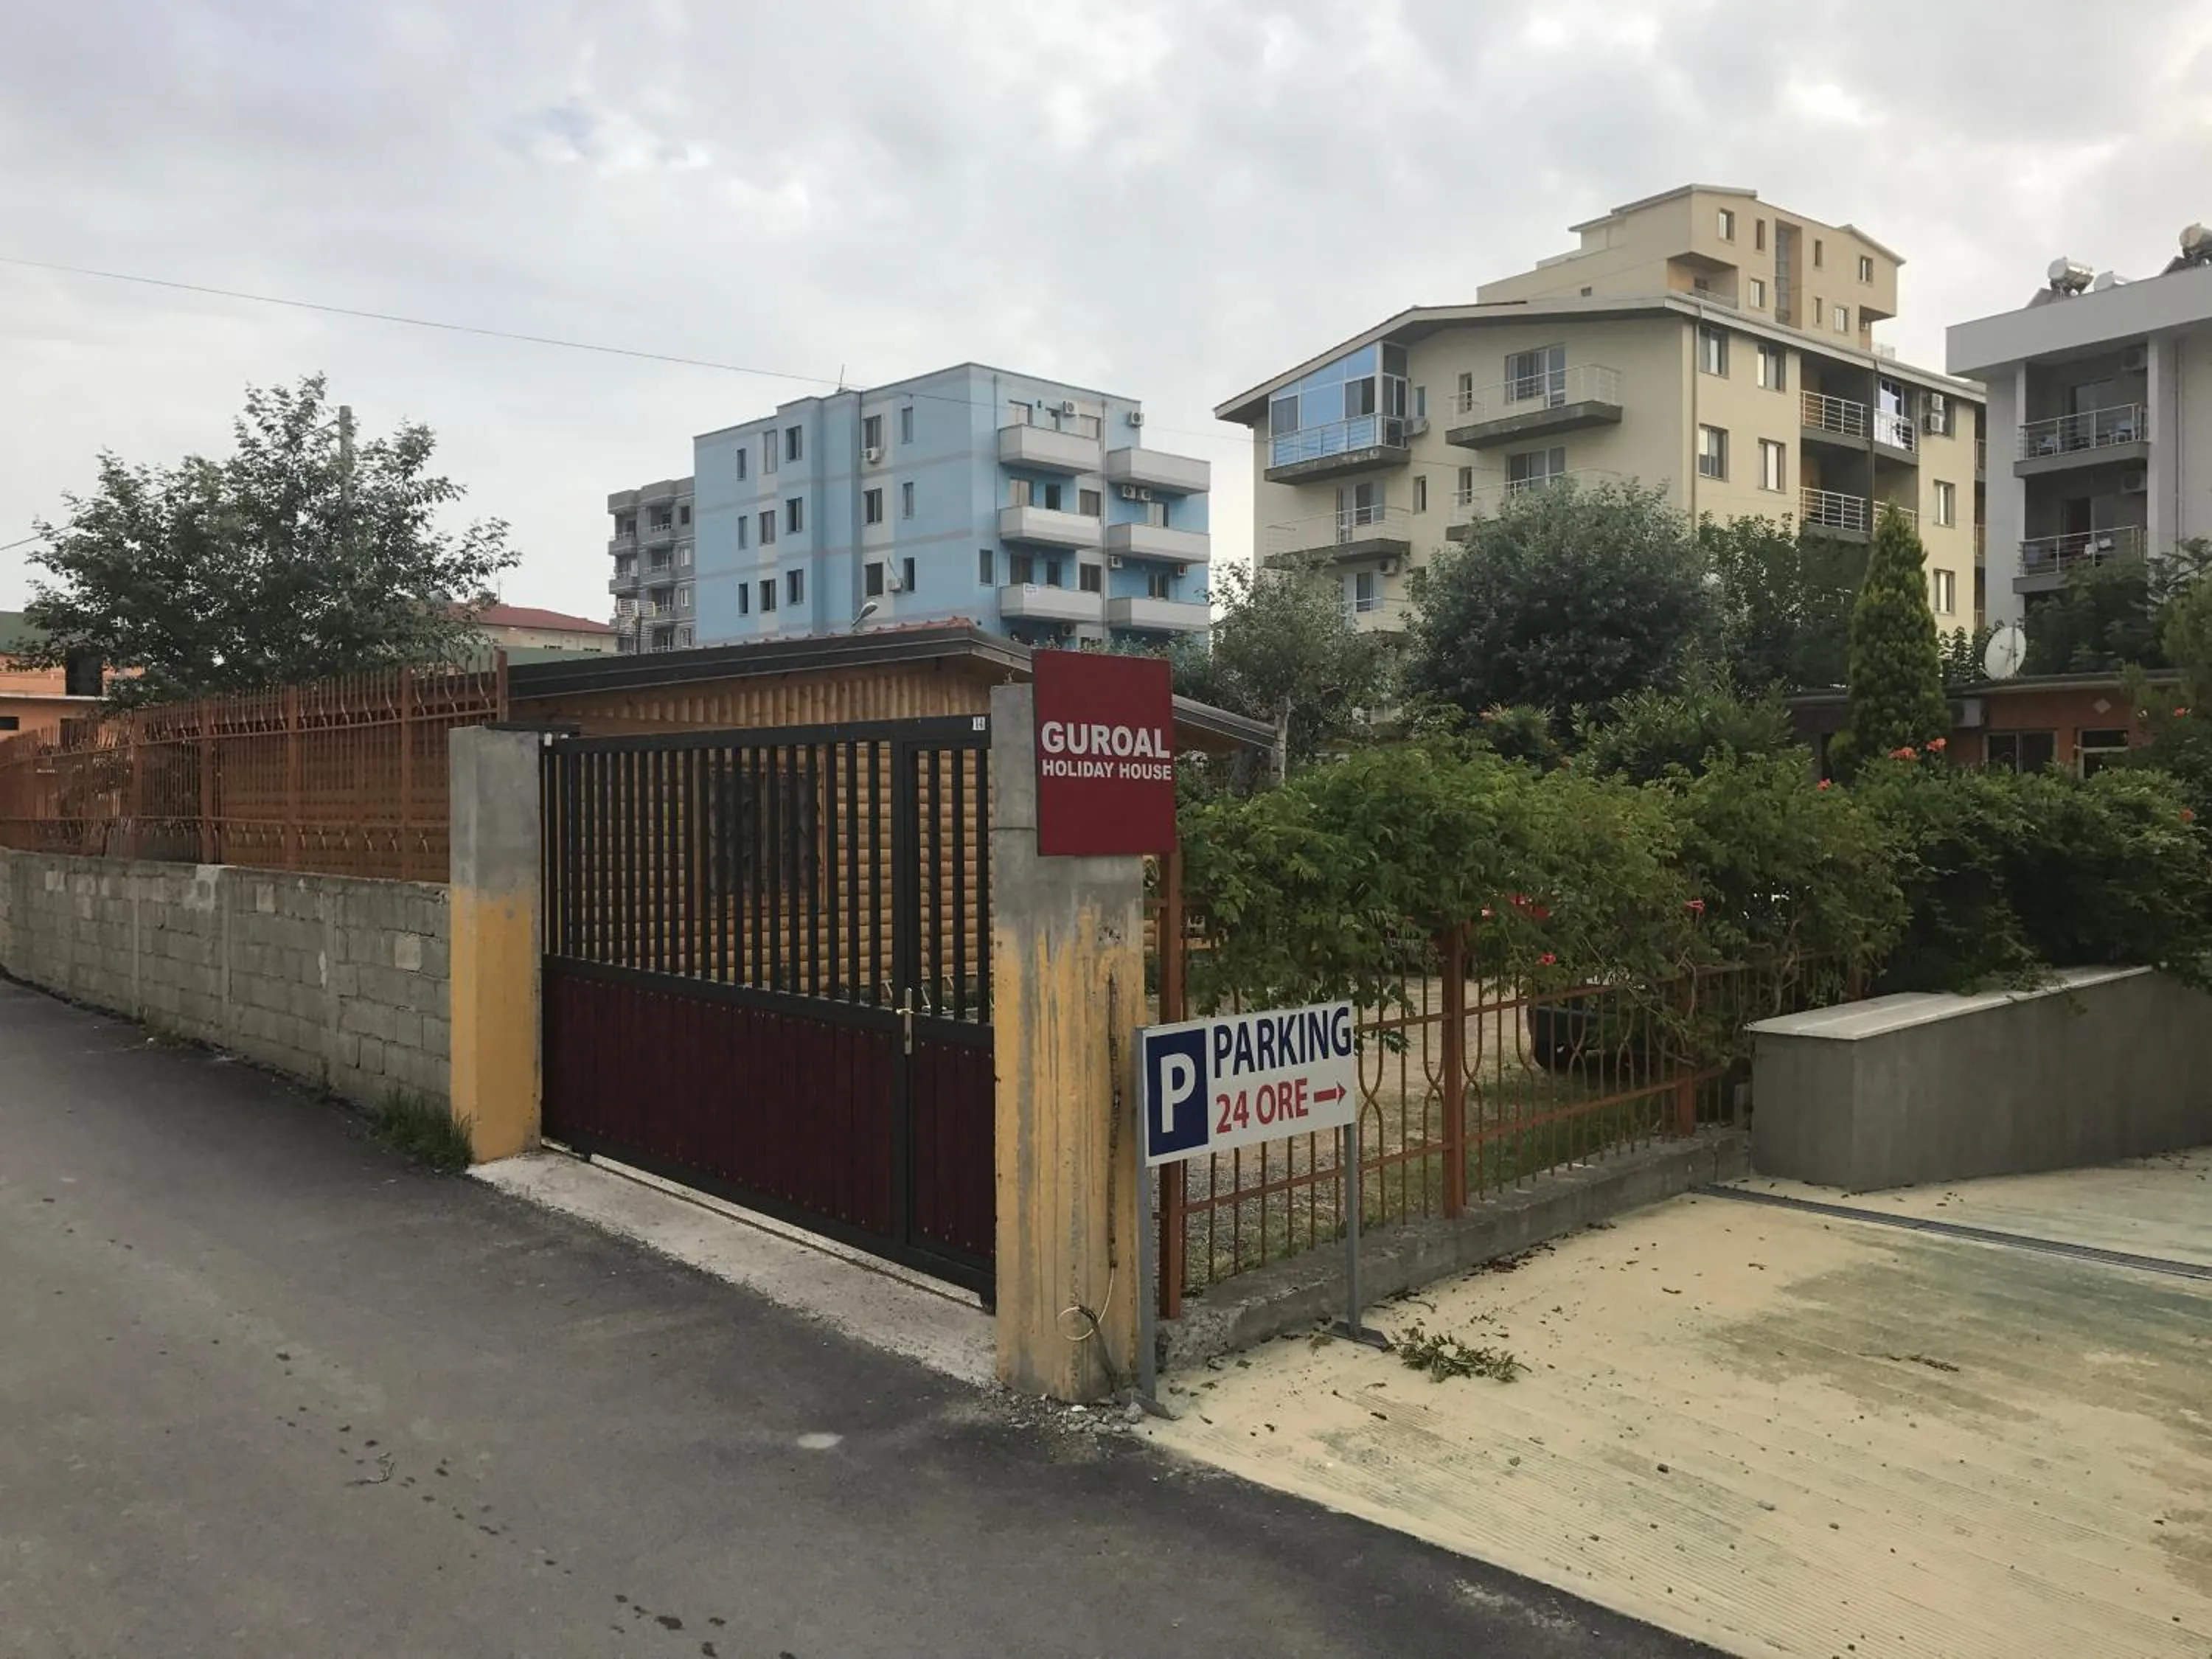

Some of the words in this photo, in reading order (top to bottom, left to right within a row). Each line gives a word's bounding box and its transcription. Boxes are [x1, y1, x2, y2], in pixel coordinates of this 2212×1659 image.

[1041, 721, 1170, 759] GUROAL
[1043, 759, 1114, 779] HOLIDAY
[1119, 762, 1172, 780] HOUSE
[1213, 1006, 1352, 1079] PARKING
[1160, 1052, 1196, 1133] P
[1216, 1091, 1250, 1134] 24
[1256, 1077, 1309, 1125] ORE
